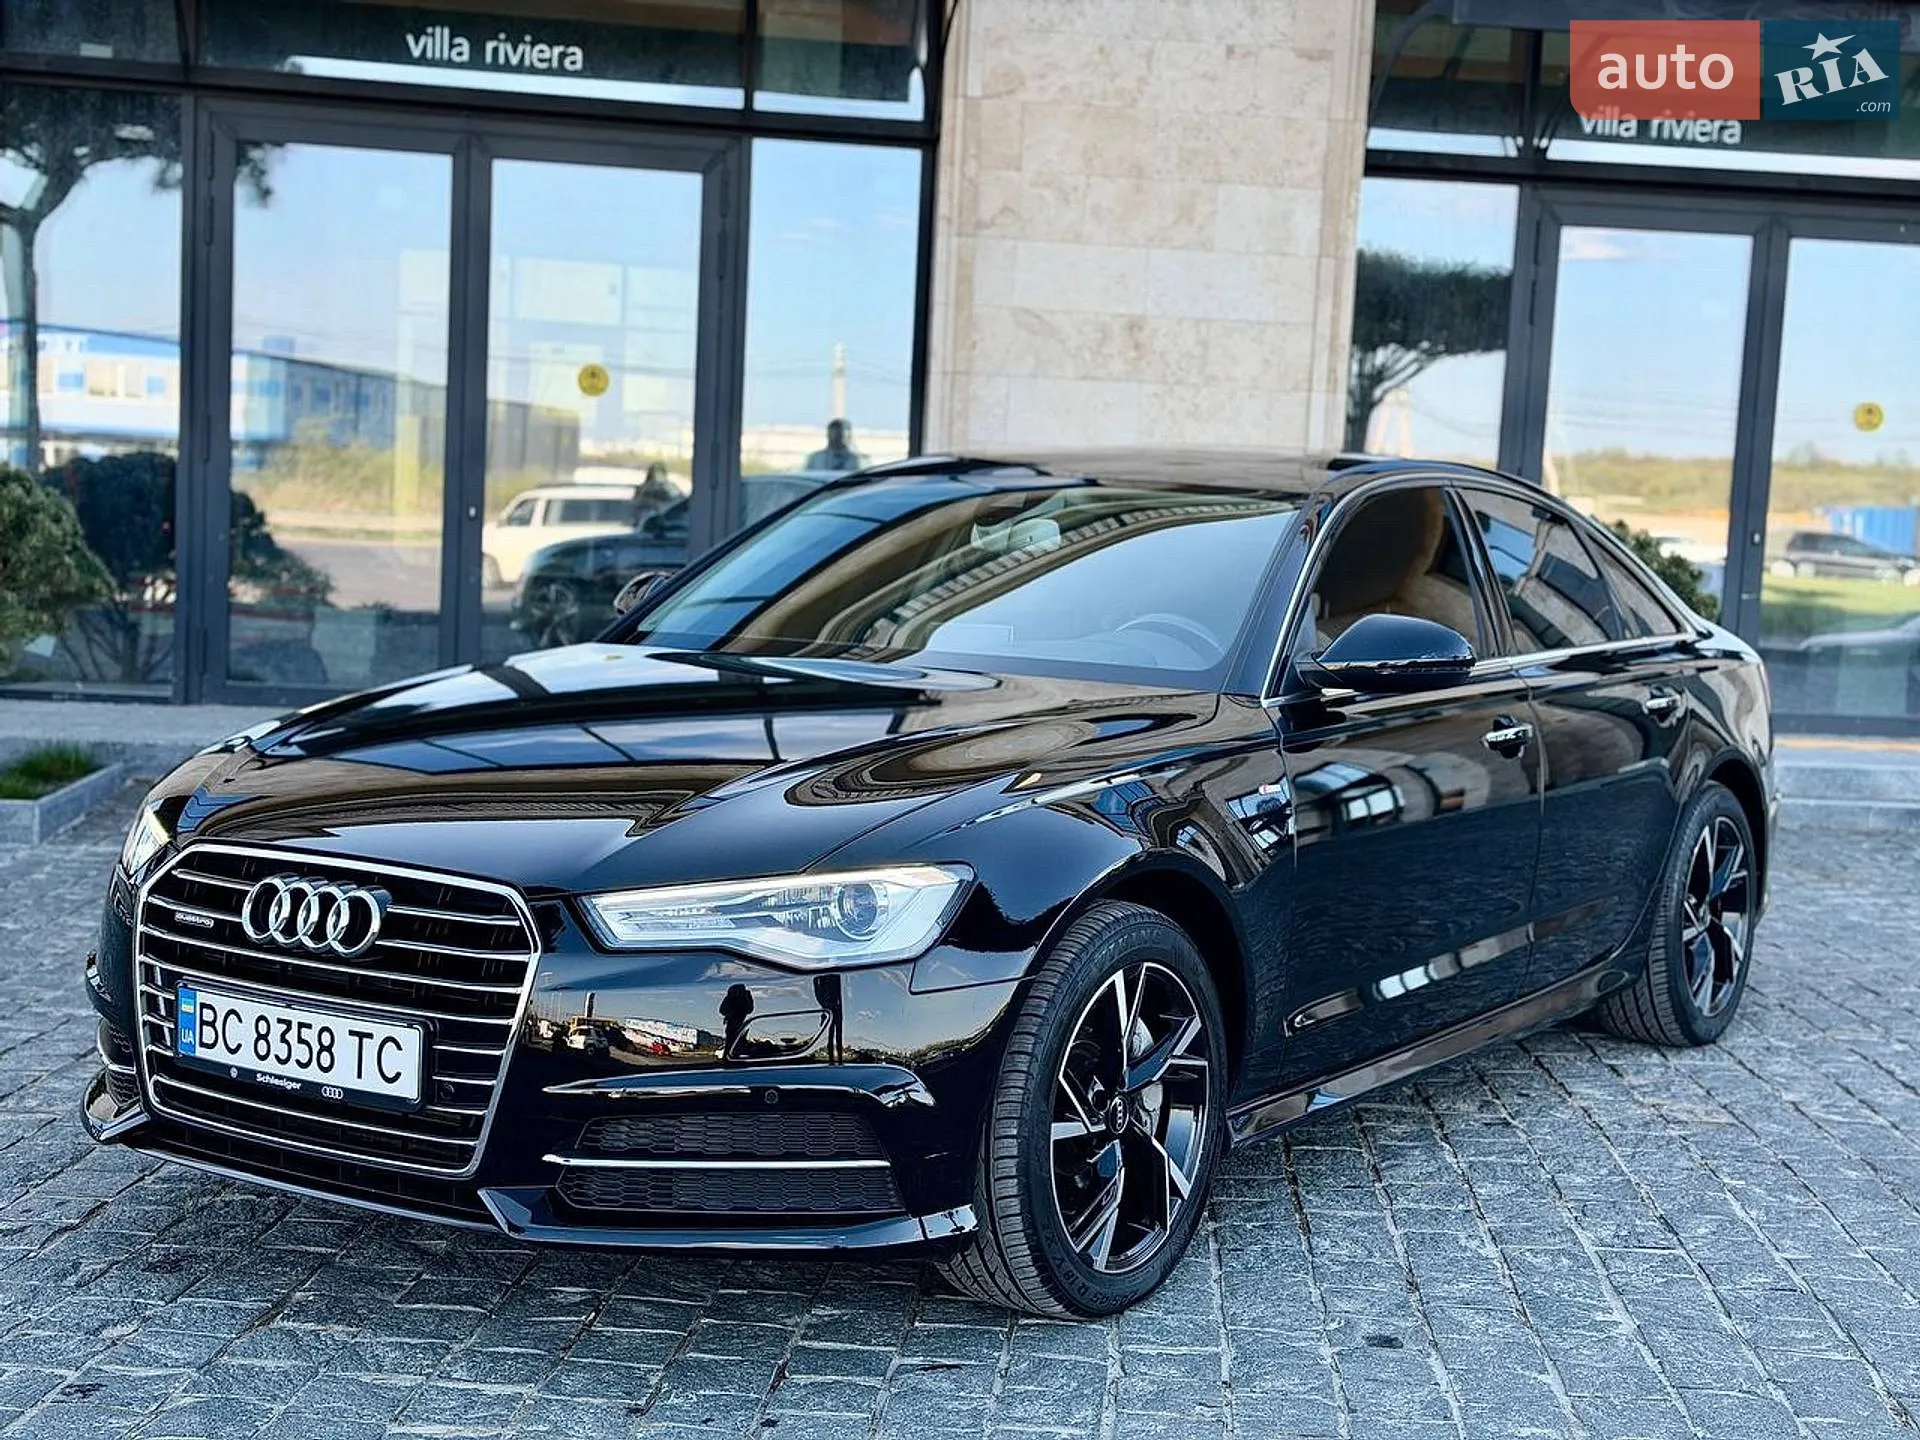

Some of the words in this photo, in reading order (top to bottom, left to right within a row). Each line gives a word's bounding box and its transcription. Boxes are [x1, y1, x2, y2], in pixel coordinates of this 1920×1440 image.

[405, 26, 470, 62] villa
[484, 32, 583, 71] riviera
[1580, 105, 1638, 138] villa
[1651, 108, 1742, 145] riviera
[181, 1028, 195, 1044] UA
[199, 1002, 243, 1055] BC
[253, 1014, 336, 1074] 8358
[348, 1029, 403, 1084] TC
